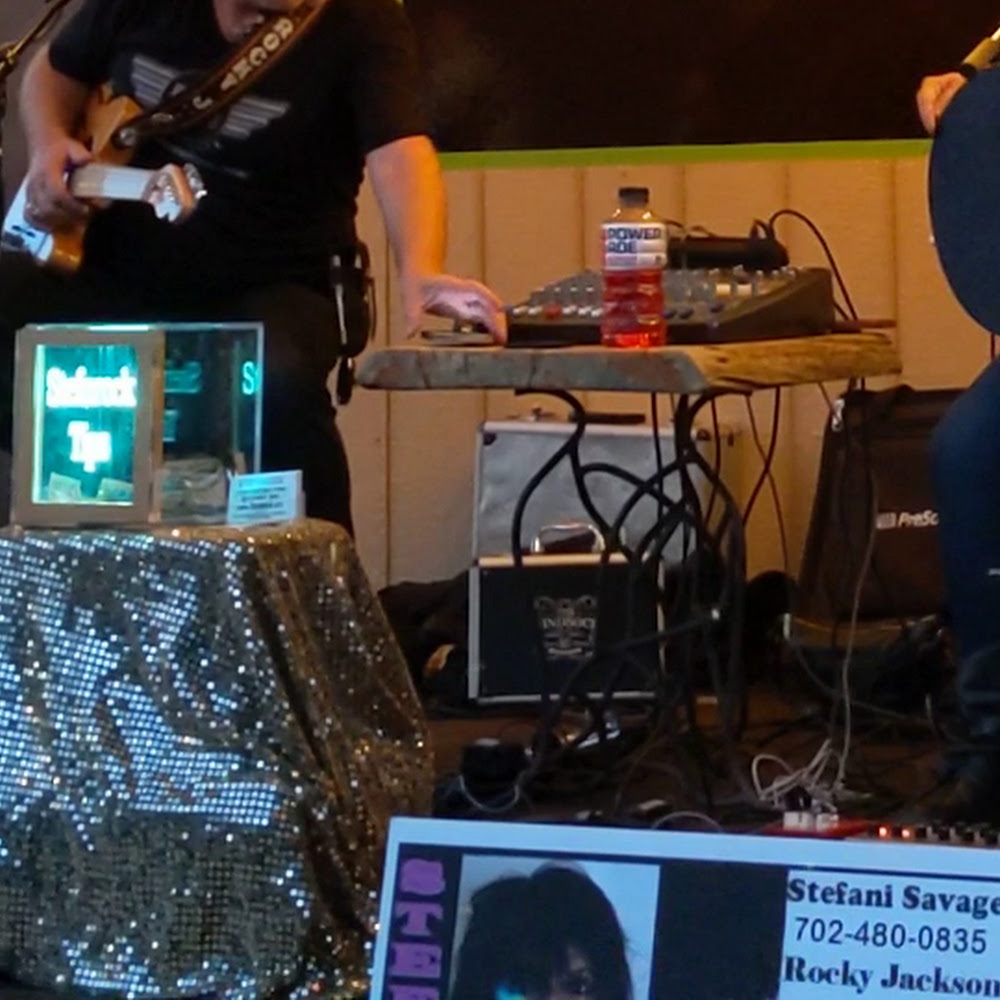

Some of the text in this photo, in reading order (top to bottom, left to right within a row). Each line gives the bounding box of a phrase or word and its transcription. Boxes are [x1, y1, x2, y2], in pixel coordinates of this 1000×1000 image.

[785, 878, 893, 909] Stefani
[795, 916, 987, 955] 702-480-0835
[783, 955, 1000, 998] Rocky Jackson
